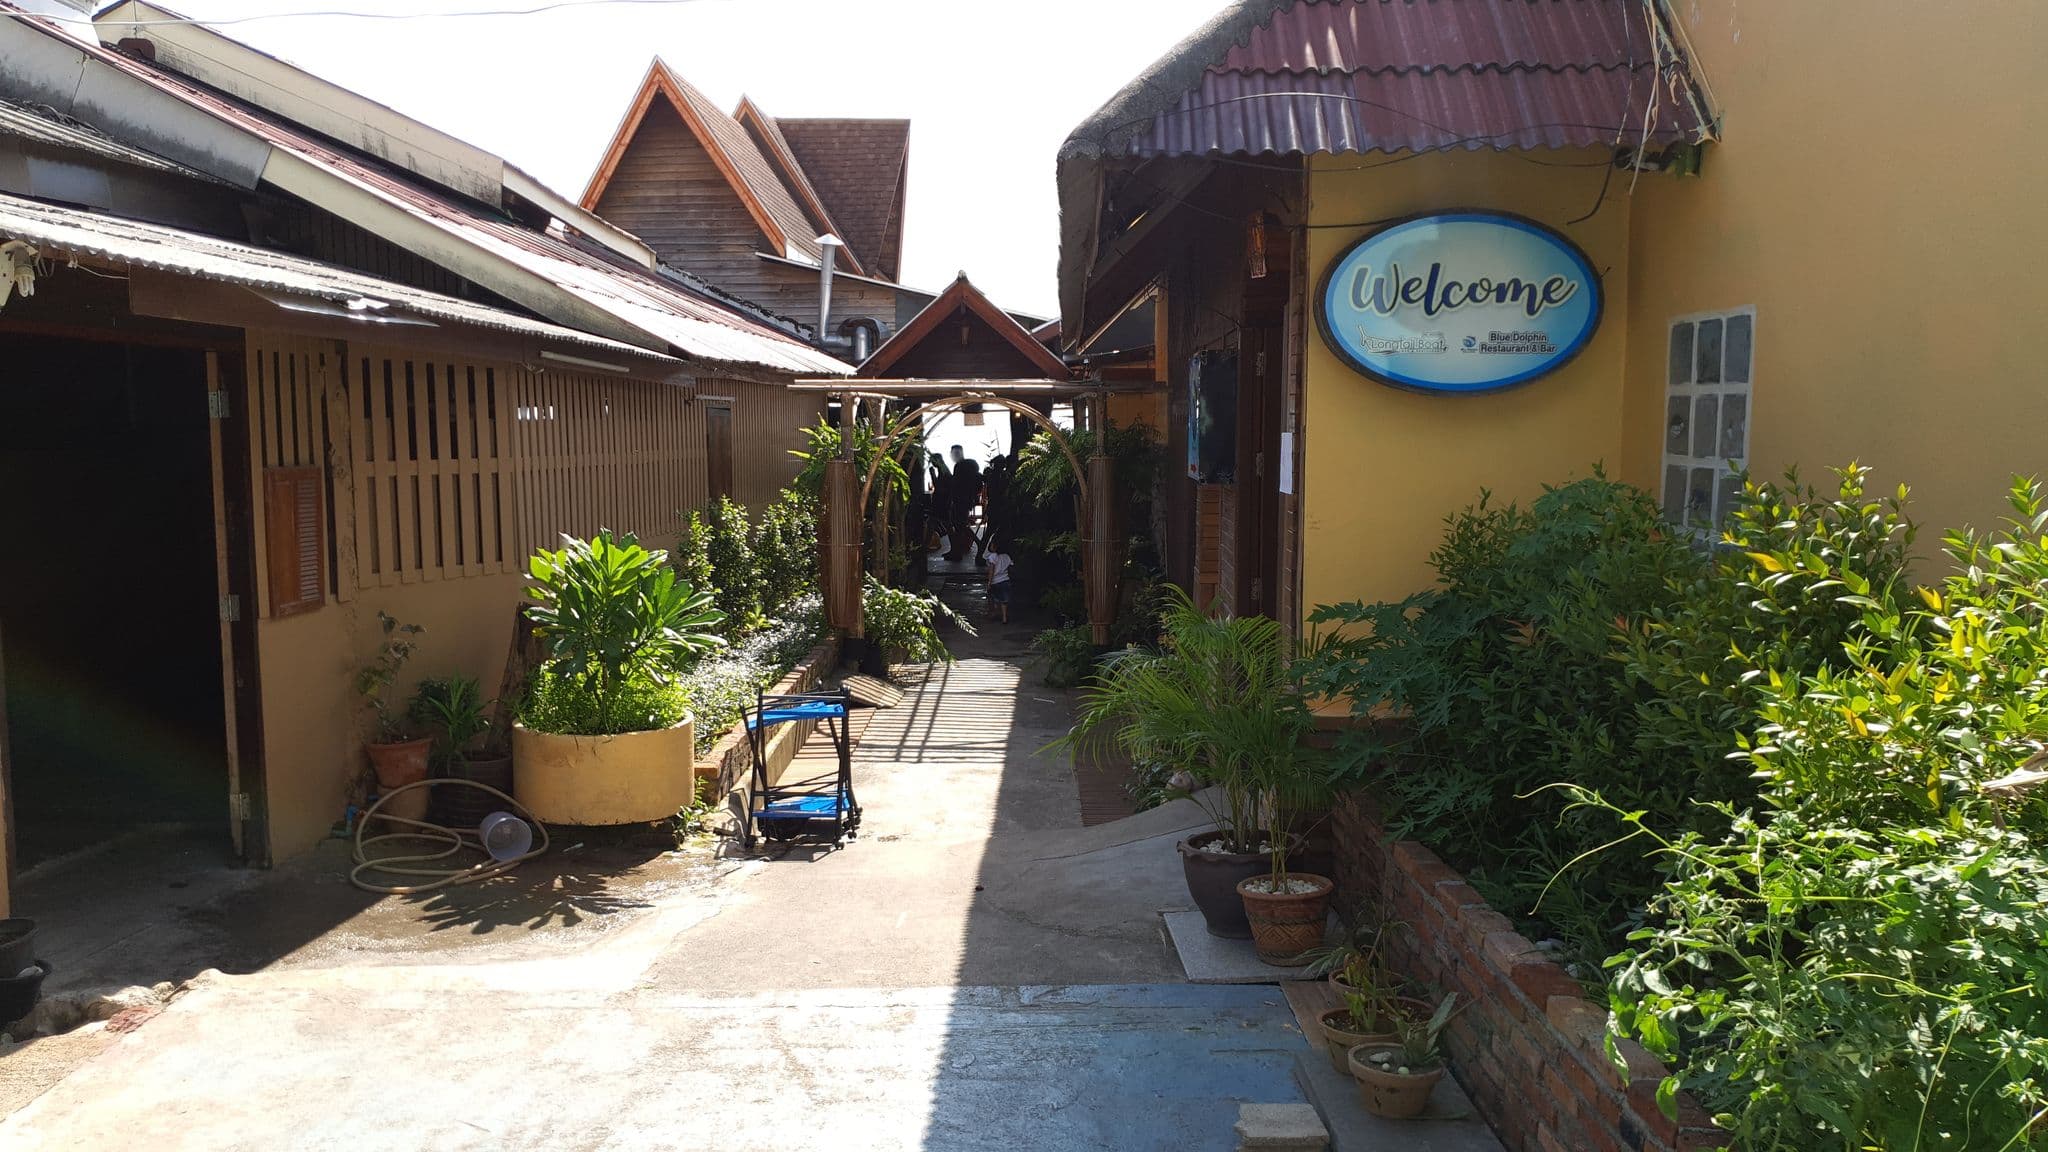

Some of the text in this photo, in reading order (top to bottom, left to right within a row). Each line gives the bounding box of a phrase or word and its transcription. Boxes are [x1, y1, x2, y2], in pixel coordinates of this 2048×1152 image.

[1352, 262, 1576, 316] Welcome
[1490, 332, 1547, 342] Blue Dolphin
[1418, 338, 1444, 350] Boat
[1481, 344, 1529, 353] Restaurant
[1531, 344, 1538, 353] &
[1541, 344, 1556, 353] Bar
